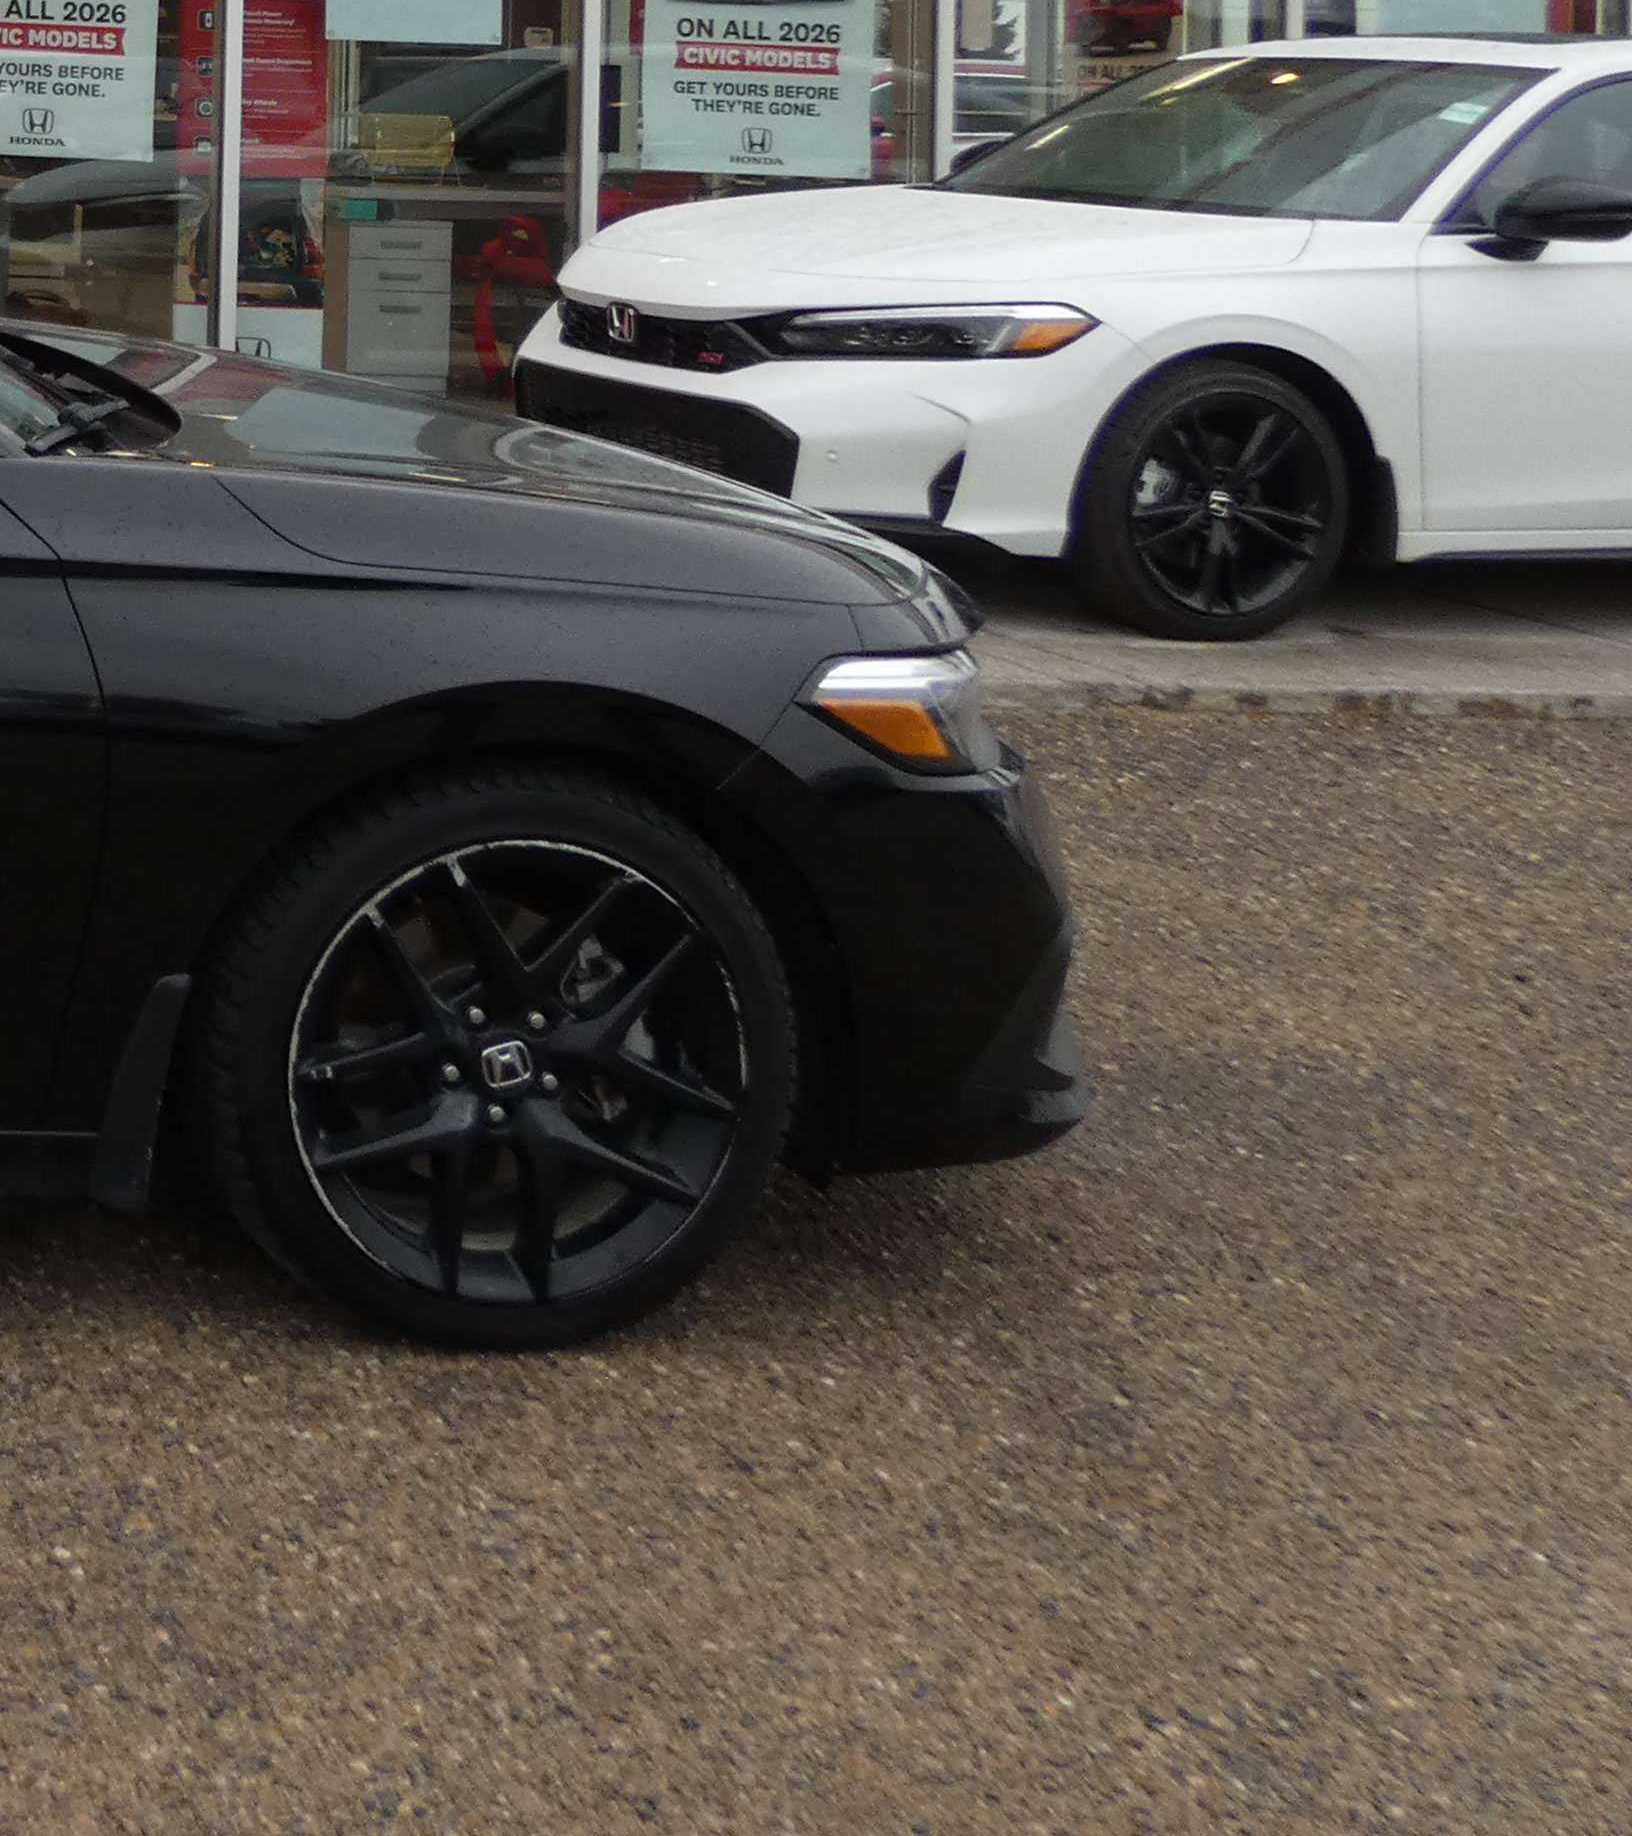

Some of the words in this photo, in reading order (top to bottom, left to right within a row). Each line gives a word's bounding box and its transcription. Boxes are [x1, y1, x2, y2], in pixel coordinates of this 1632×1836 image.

[5, 0, 54, 20] ALL
[63, 2, 127, 24] 2026
[28, 30, 118, 50] MODELS
[676, 18, 714, 38] ON
[723, 20, 770, 40] ALL
[779, 22, 841, 44] 2026
[684, 47, 740, 65] CIVIC
[745, 49, 833, 69] MODELS
[57, 66, 124, 81] BEFORE
[52, 82, 106, 98] GONE.
[674, 81, 707, 94] GET
[712, 82, 769, 98] YOURS
[774, 85, 839, 100] BEFORE
[691, 98, 764, 114] THEY'RE
[768, 102, 821, 117] GONE.
[9, 136, 66, 147] HONDA
[729, 155, 784, 166] HONDA
